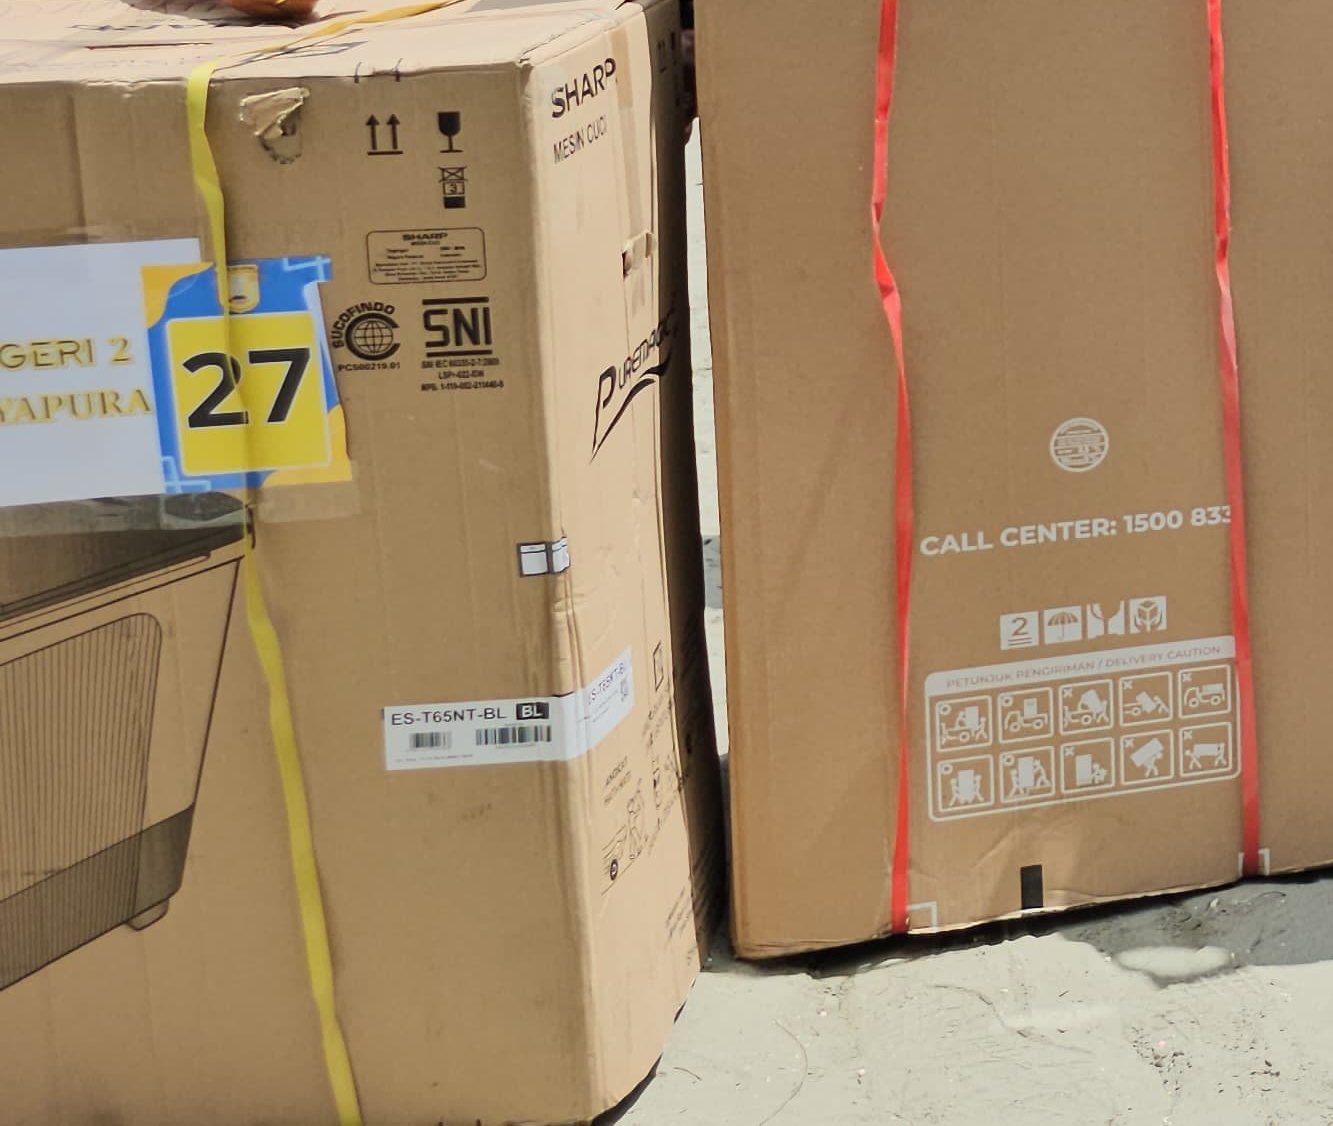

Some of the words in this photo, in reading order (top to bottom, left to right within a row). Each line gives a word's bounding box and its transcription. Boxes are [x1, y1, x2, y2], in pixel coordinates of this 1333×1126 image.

[551, 57, 617, 119] SHARP
[422, 306, 493, 348] SNI
[0, 338, 96, 370] GERI
[108, 336, 132, 363] 2
[0, 389, 153, 425] YAPURA
[181, 346, 312, 430] 27
[920, 530, 994, 557] CALL
[999, 516, 1118, 548] CENTER:
[1123, 510, 1184, 534] 1500
[1105, 651, 1165, 668] DELIVERY
[1166, 645, 1221, 660] CAUTION
[391, 707, 507, 726] ES-T65NT-BL
[521, 705, 543, 718] BL
